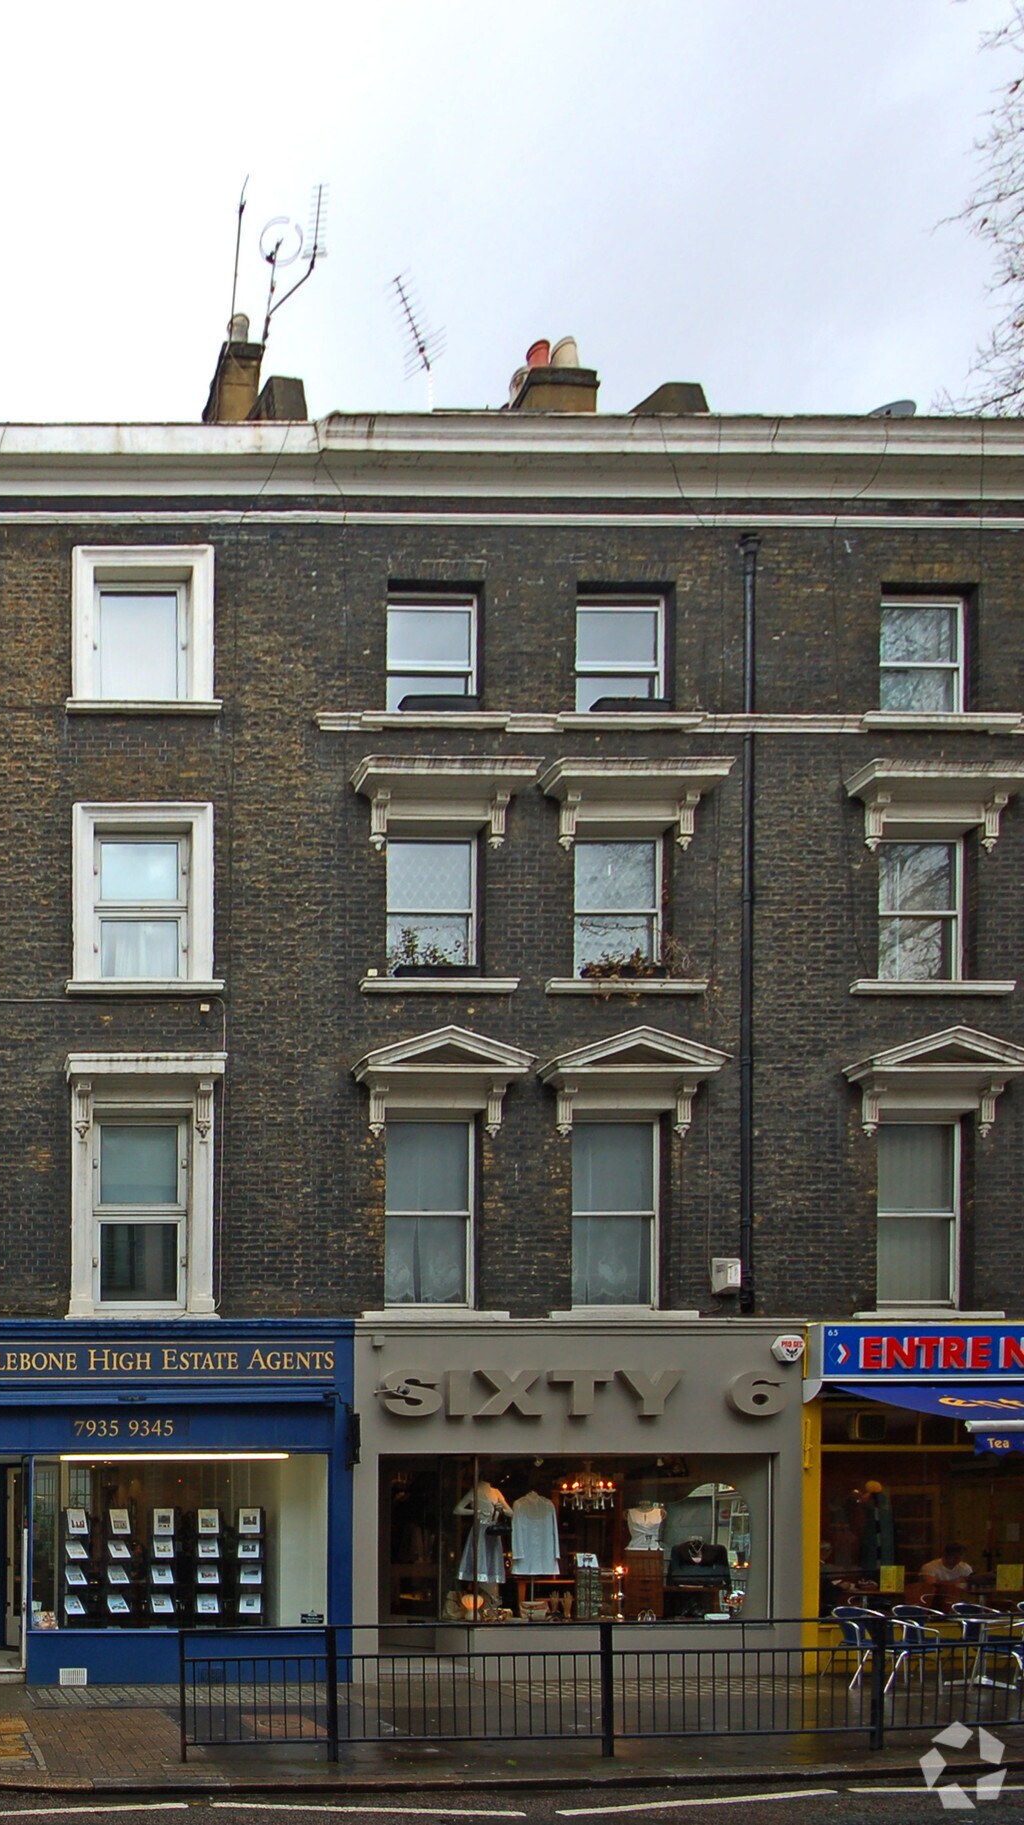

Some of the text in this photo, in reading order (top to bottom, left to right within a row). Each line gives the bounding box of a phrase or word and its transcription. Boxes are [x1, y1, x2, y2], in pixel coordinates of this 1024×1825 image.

[827, 1329, 839, 1337] 65
[88, 1349, 152, 1372] HIGH
[162, 1349, 239, 1371] ESTATE
[247, 1348, 335, 1371] AGENTS
[859, 1336, 992, 1370] ENTRE
[379, 1369, 787, 1418] SIXTY 6
[75, 1420, 174, 1438] 7935 9345
[987, 1438, 1010, 1449] Tea
